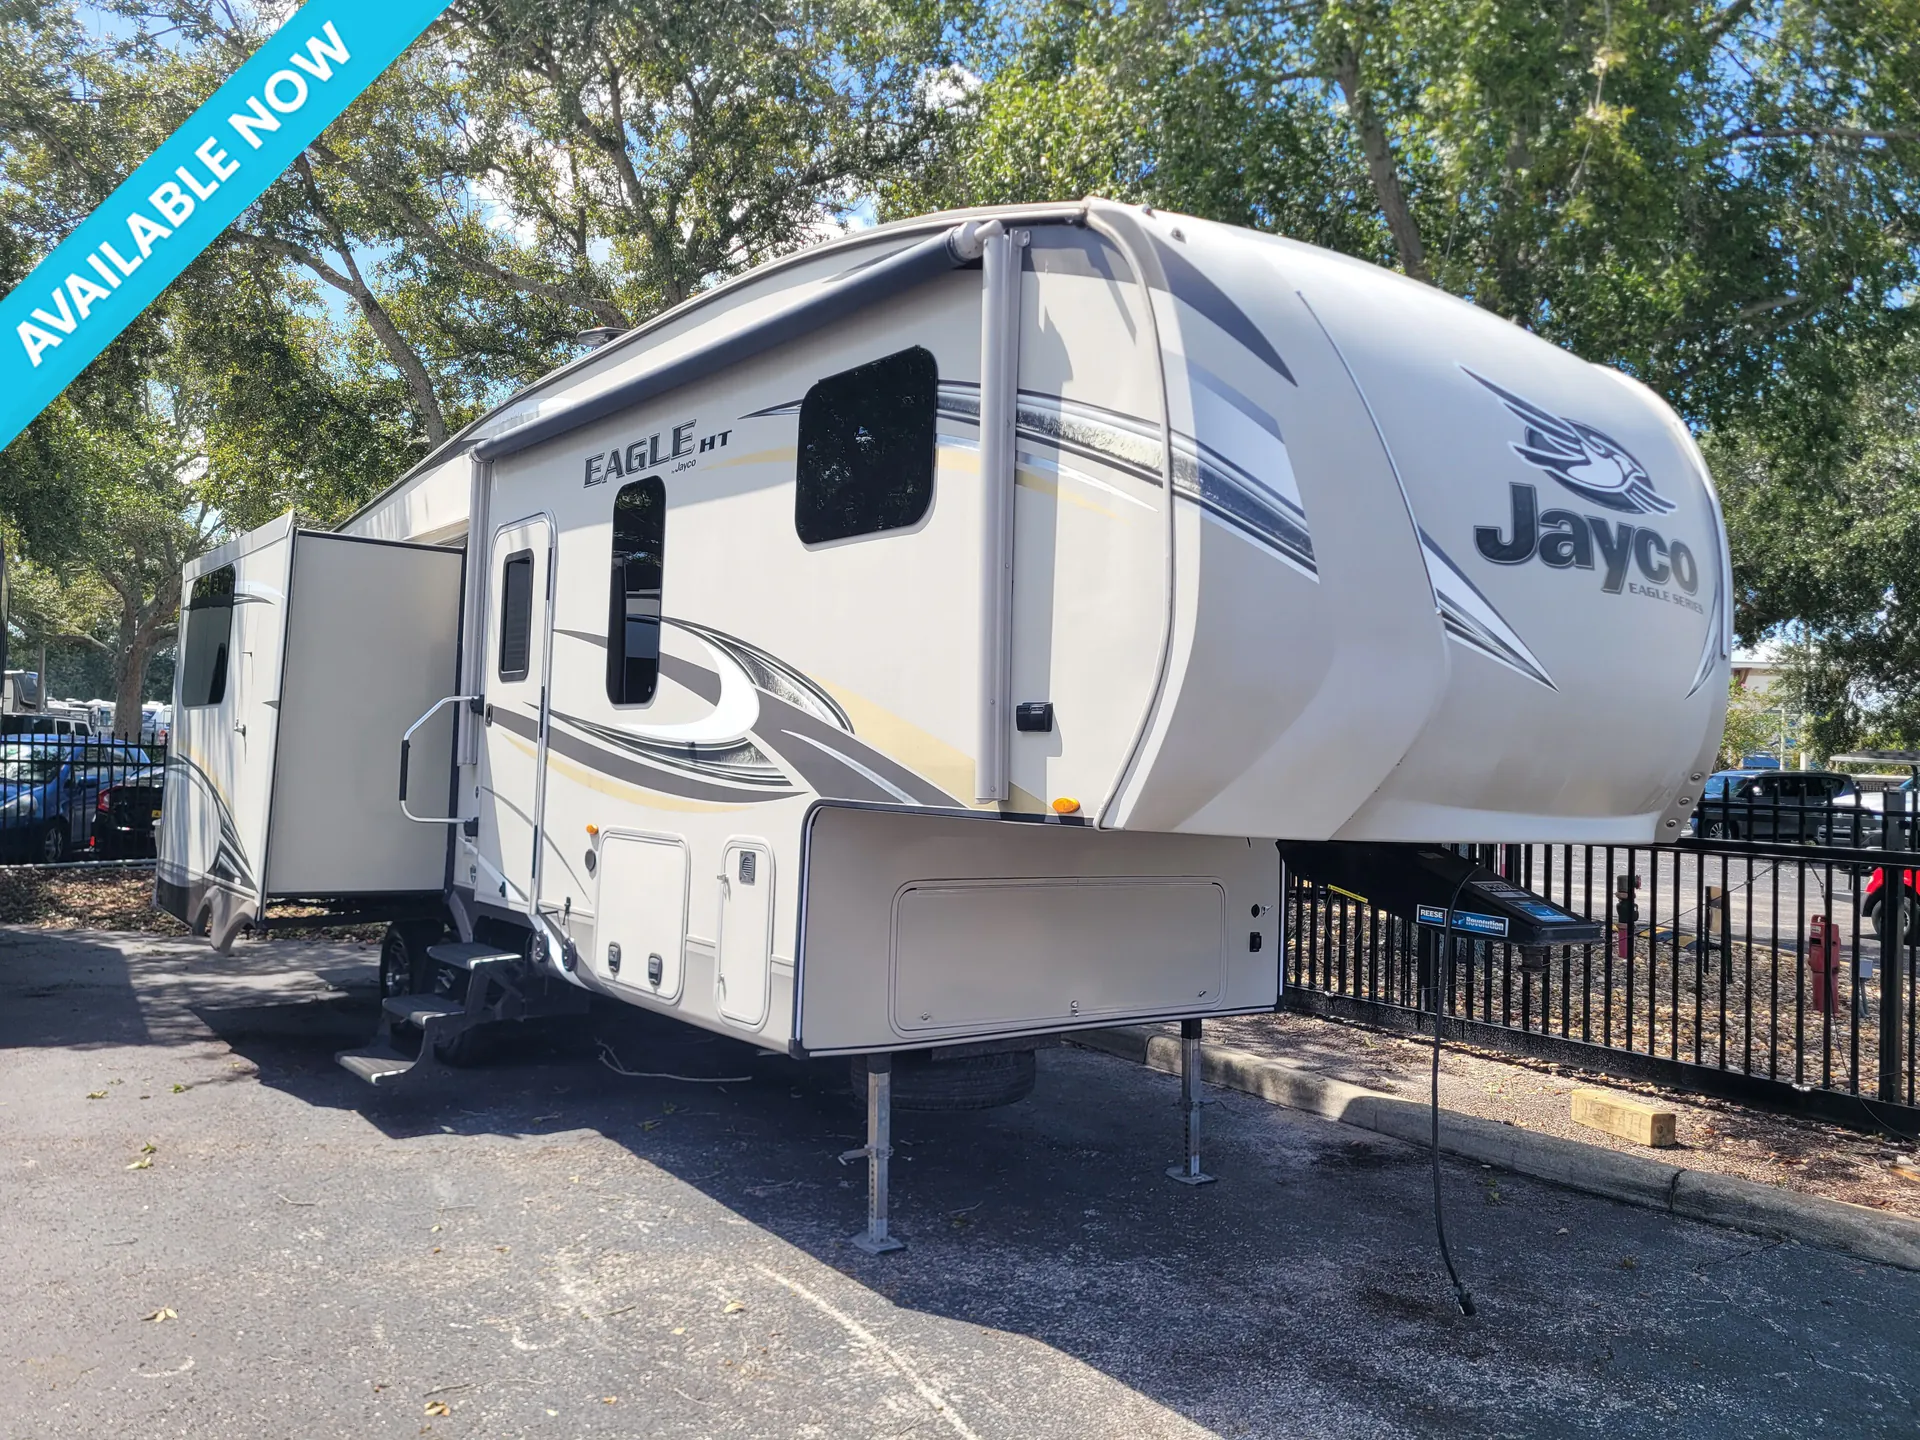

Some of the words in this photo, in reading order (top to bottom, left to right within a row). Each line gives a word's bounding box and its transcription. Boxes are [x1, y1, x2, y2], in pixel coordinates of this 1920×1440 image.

[583, 419, 697, 488] EAGLE
[699, 430, 733, 454] HT
[1473, 481, 1699, 596] Jayco
[1628, 582, 1671, 602] EAGLE
[1672, 594, 1704, 615] SERIES
[1420, 909, 1443, 919] REESE
